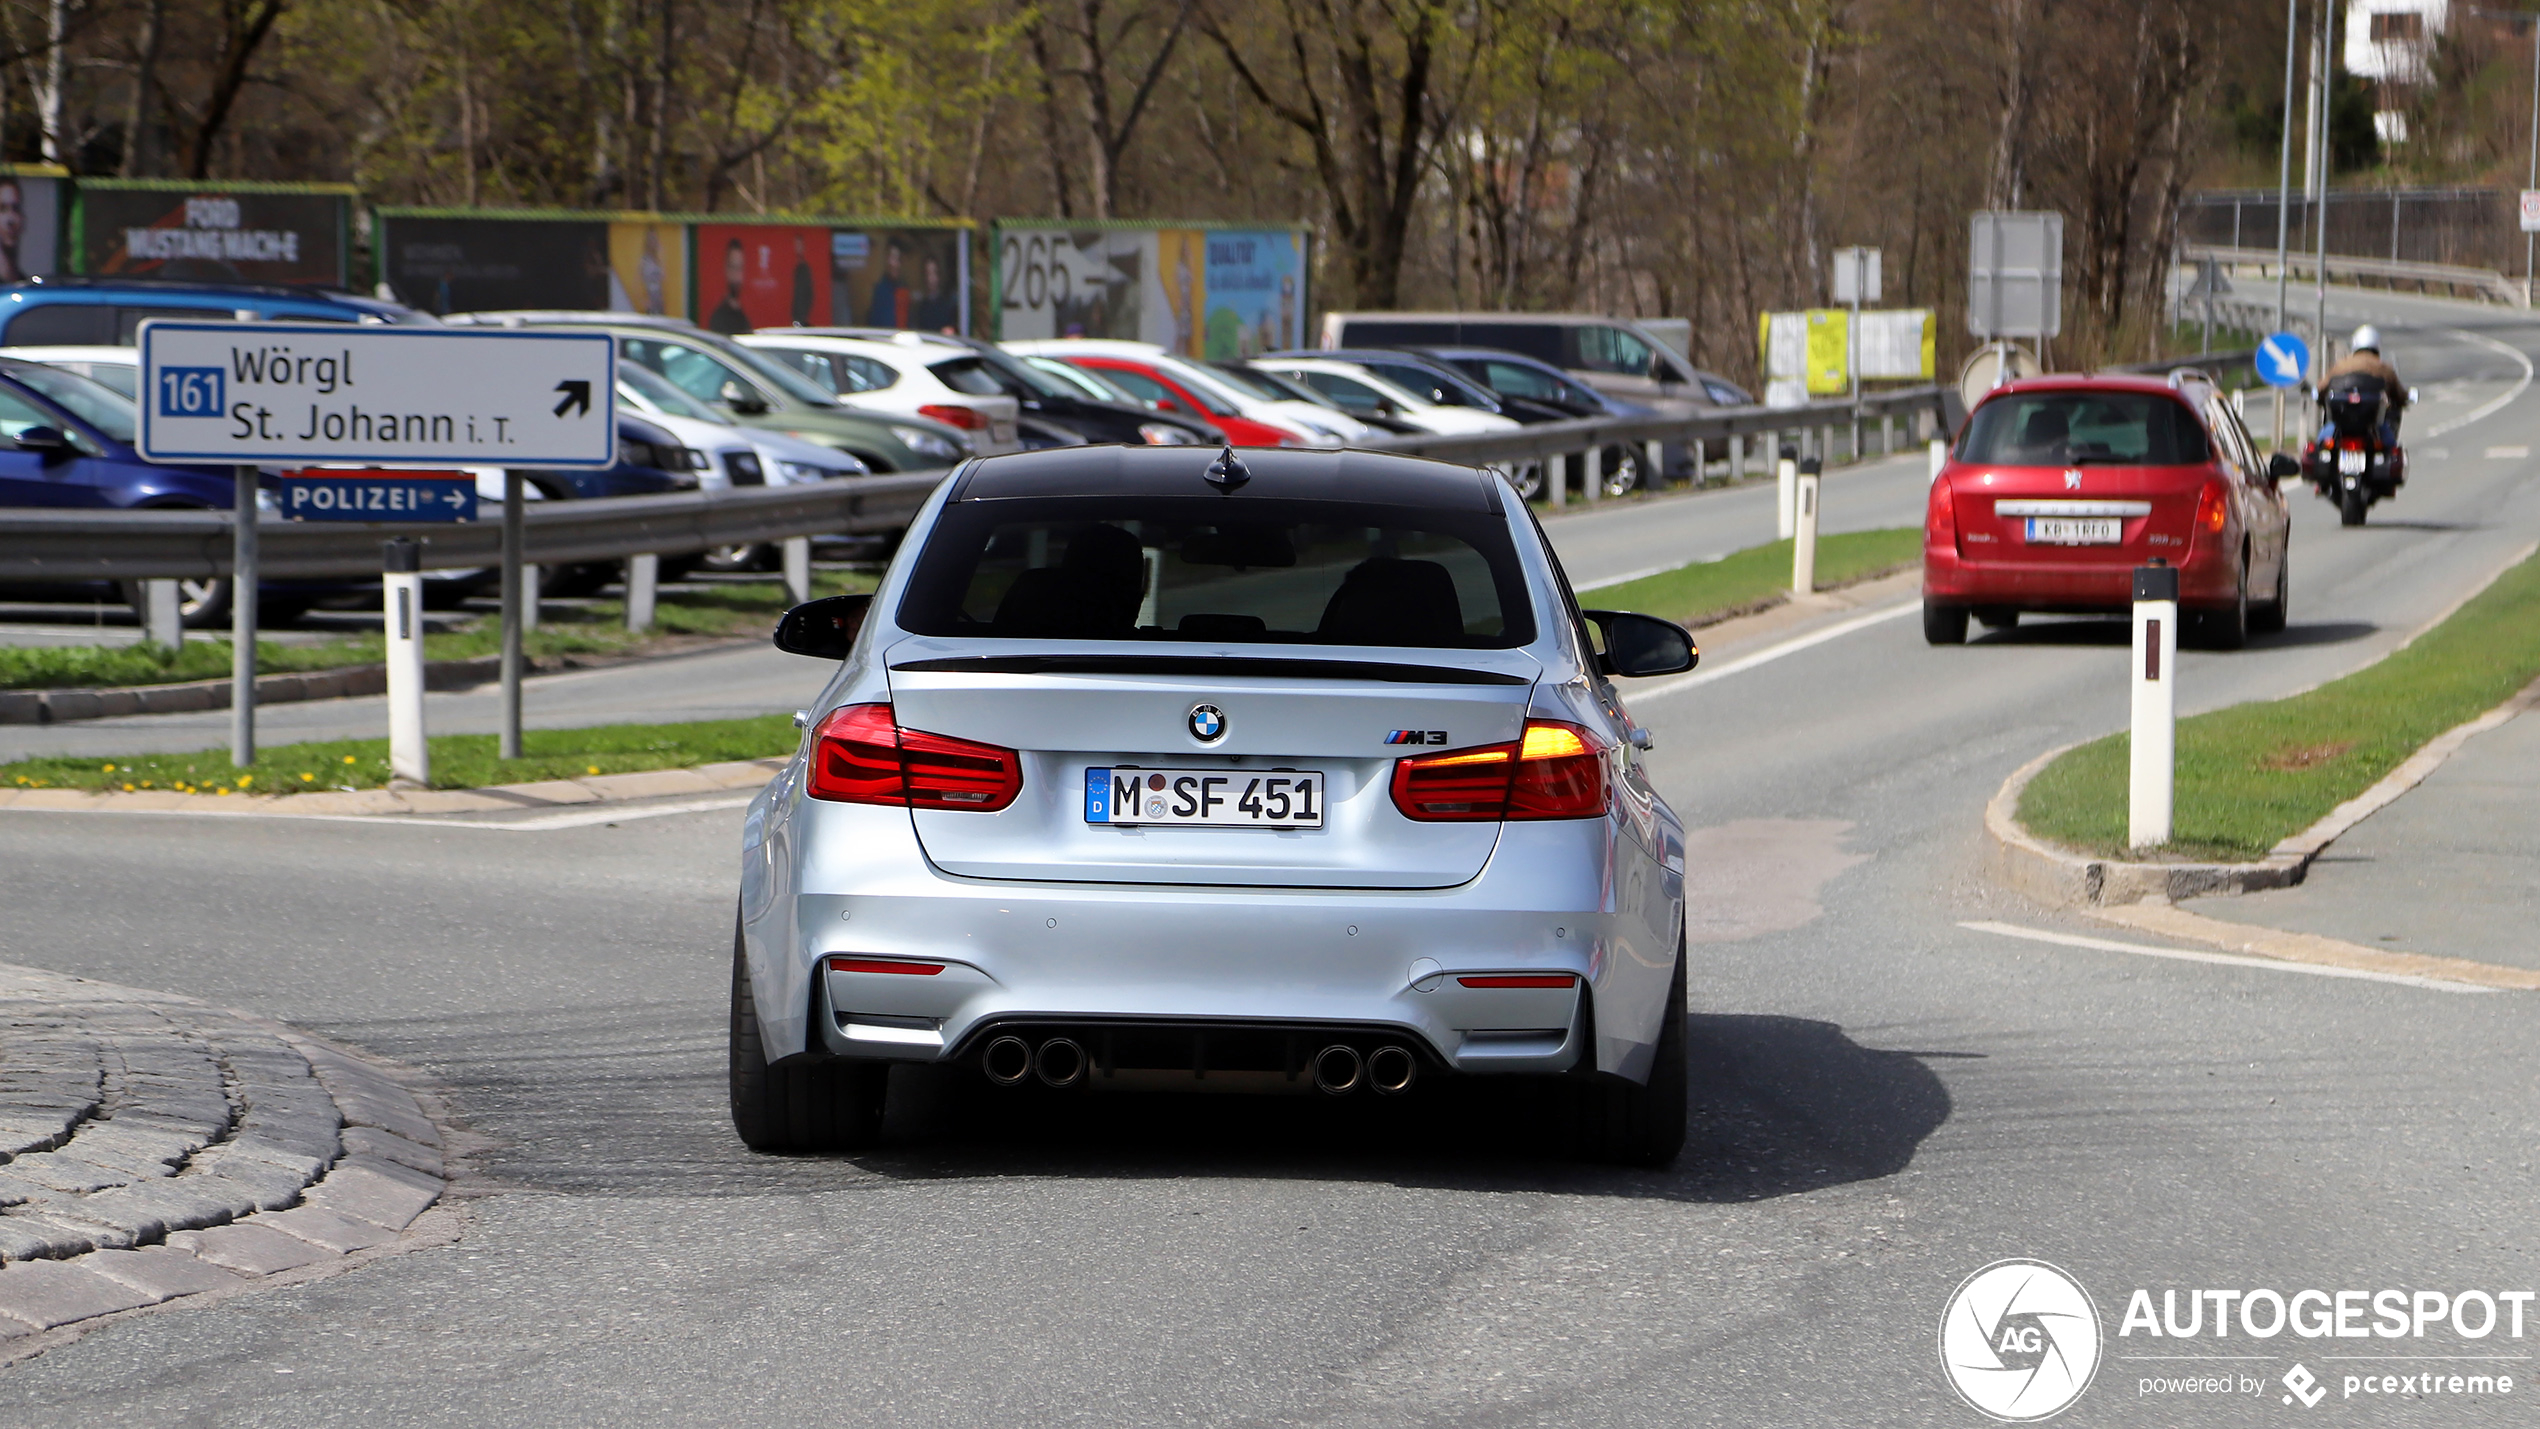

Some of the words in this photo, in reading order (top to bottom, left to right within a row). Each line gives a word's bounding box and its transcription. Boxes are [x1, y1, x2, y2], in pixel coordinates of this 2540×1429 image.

[231, 346, 353, 394] Wörgl
[162, 373, 219, 412] 161
[231, 403, 284, 440] St.
[298, 404, 454, 443] Johann
[467, 416, 483, 443] i.
[493, 418, 515, 443] T.
[292, 486, 417, 511] POLIZEI
[1192, 704, 1223, 718] BMW
[1394, 730, 1447, 745] M3
[1093, 801, 1103, 813] D
[1113, 776, 1141, 816] M
[1172, 776, 1228, 817] SF
[1238, 778, 1318, 819] 451
